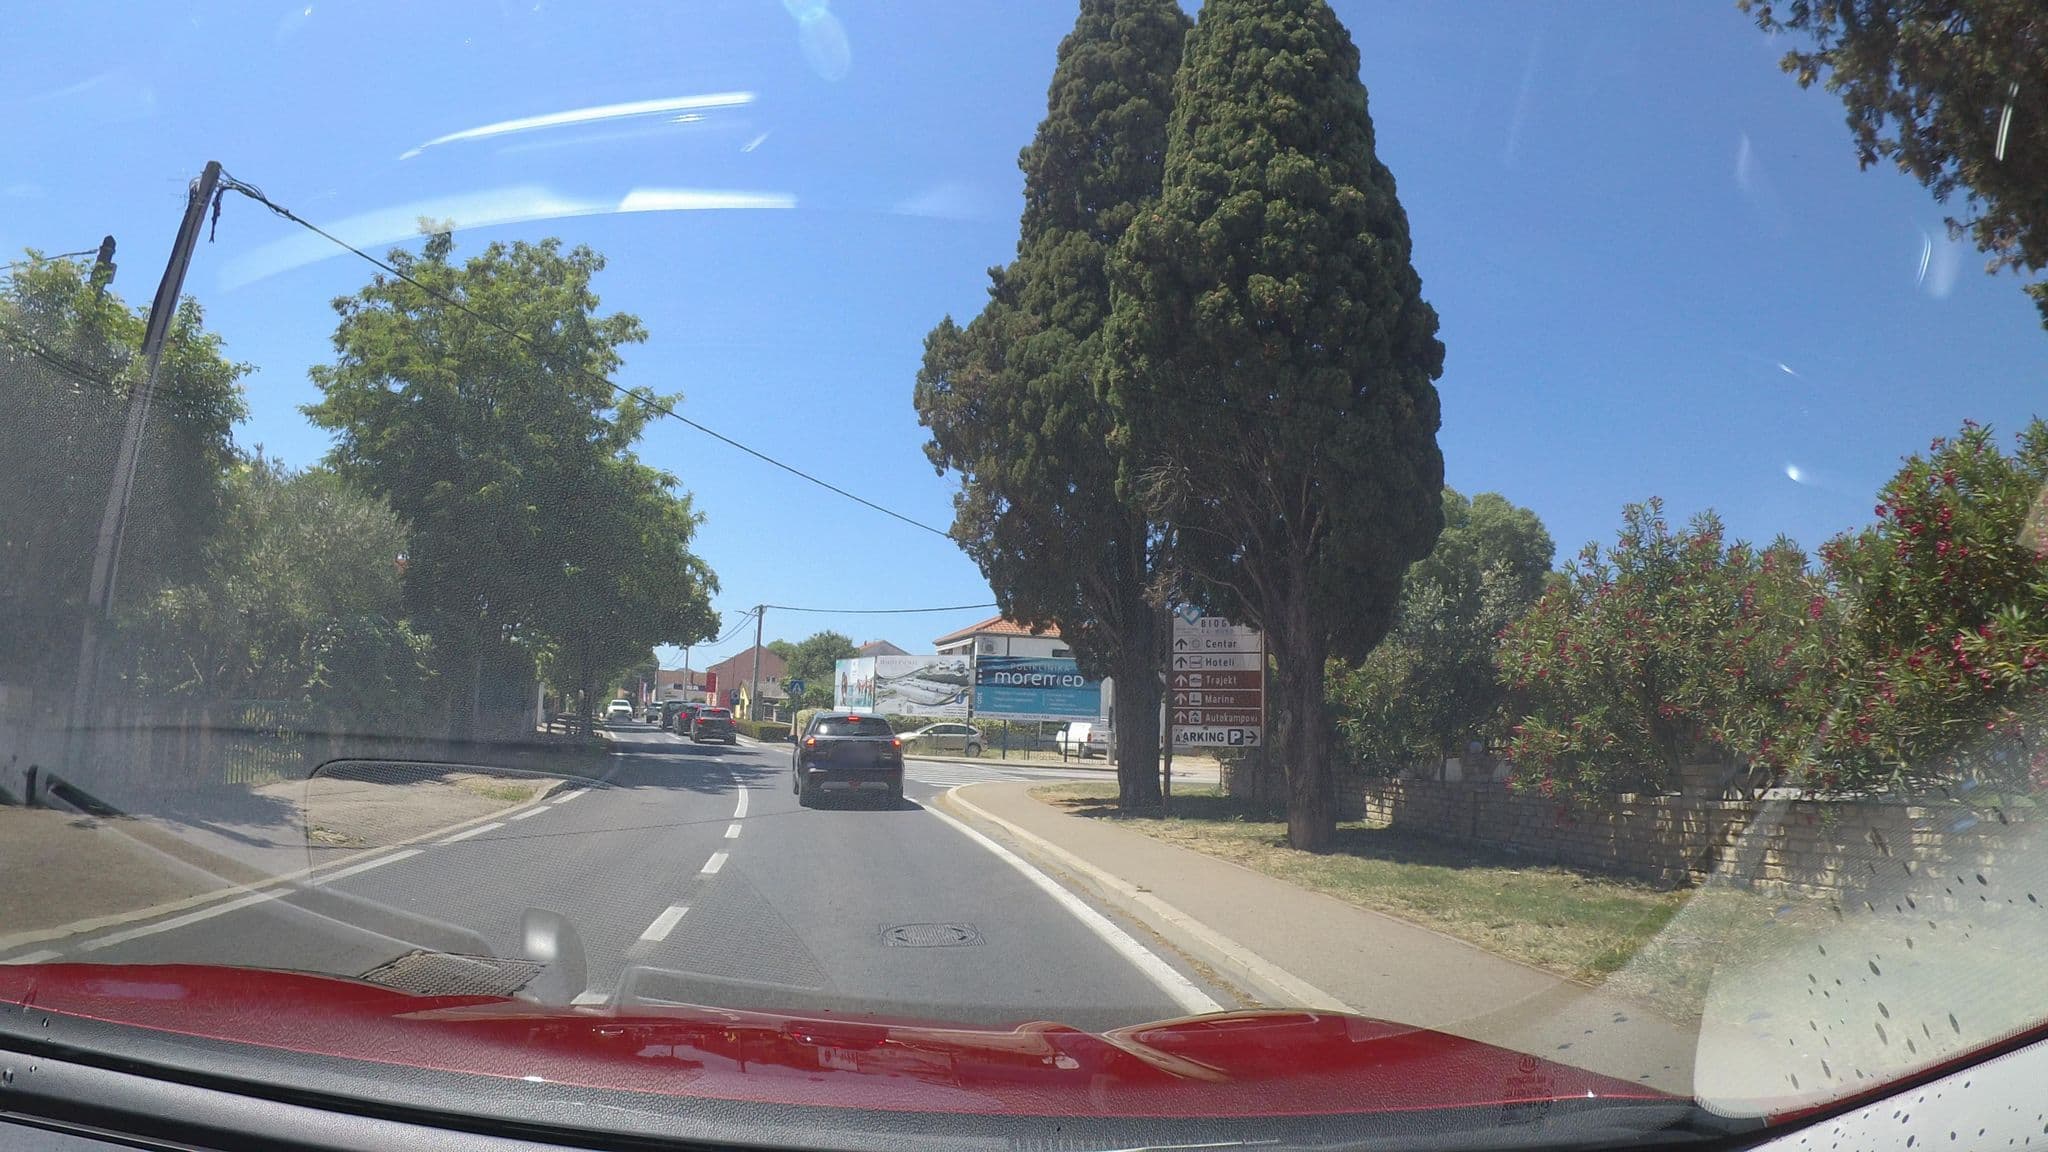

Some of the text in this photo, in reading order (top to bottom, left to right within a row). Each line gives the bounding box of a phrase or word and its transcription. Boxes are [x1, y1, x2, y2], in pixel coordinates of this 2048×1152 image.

[1201, 619, 1228, 628] BIOG
[1205, 639, 1238, 648] Centar
[1205, 658, 1235, 667] Hoteli
[1206, 675, 1237, 686] Trajekt
[1205, 694, 1235, 704] Marine
[1205, 712, 1258, 724] Autokampovi
[1182, 731, 1225, 742] ARKING
